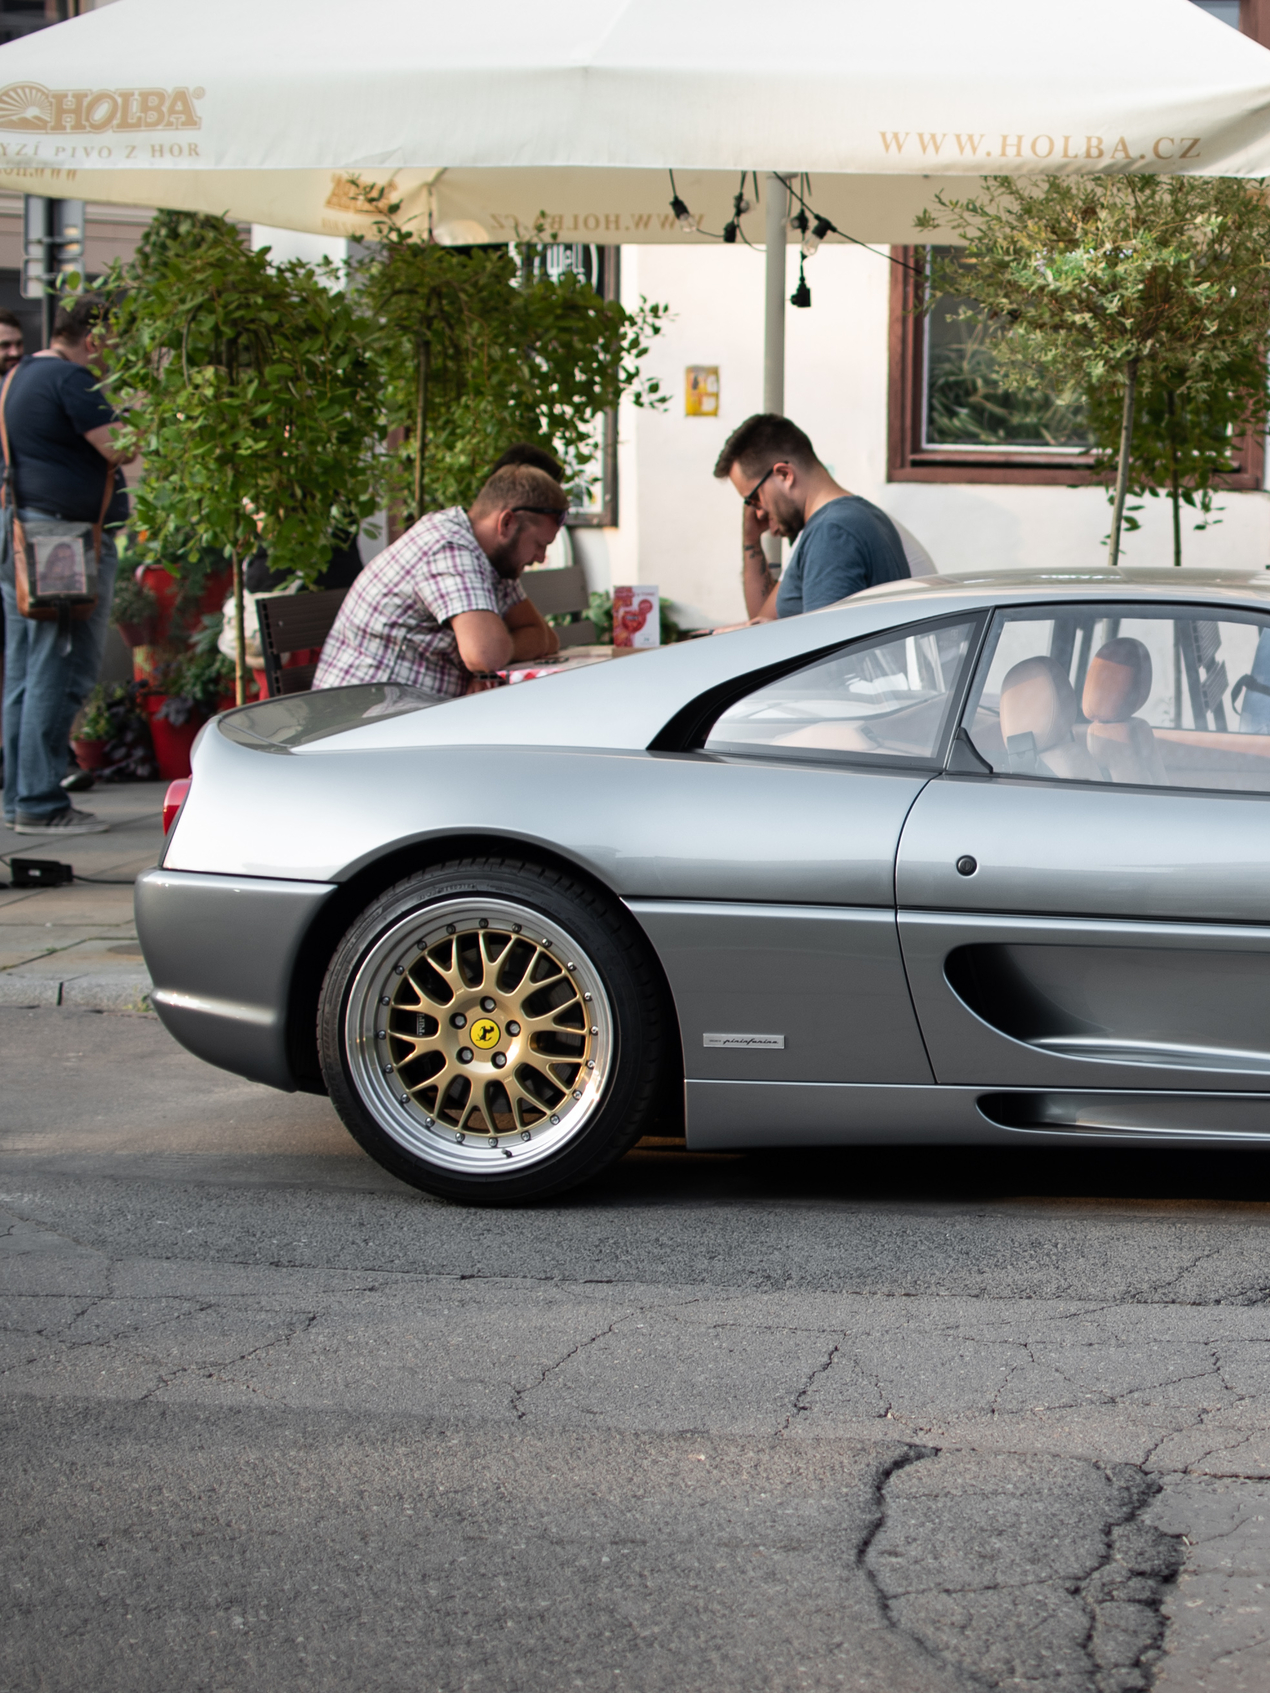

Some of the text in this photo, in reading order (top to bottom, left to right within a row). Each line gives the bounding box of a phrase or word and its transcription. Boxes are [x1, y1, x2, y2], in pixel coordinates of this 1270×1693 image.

[0, 141, 201, 159] YZÍ PIVO Z HOR
[878, 131, 1202, 160] WWW.HOLBA.CZ
